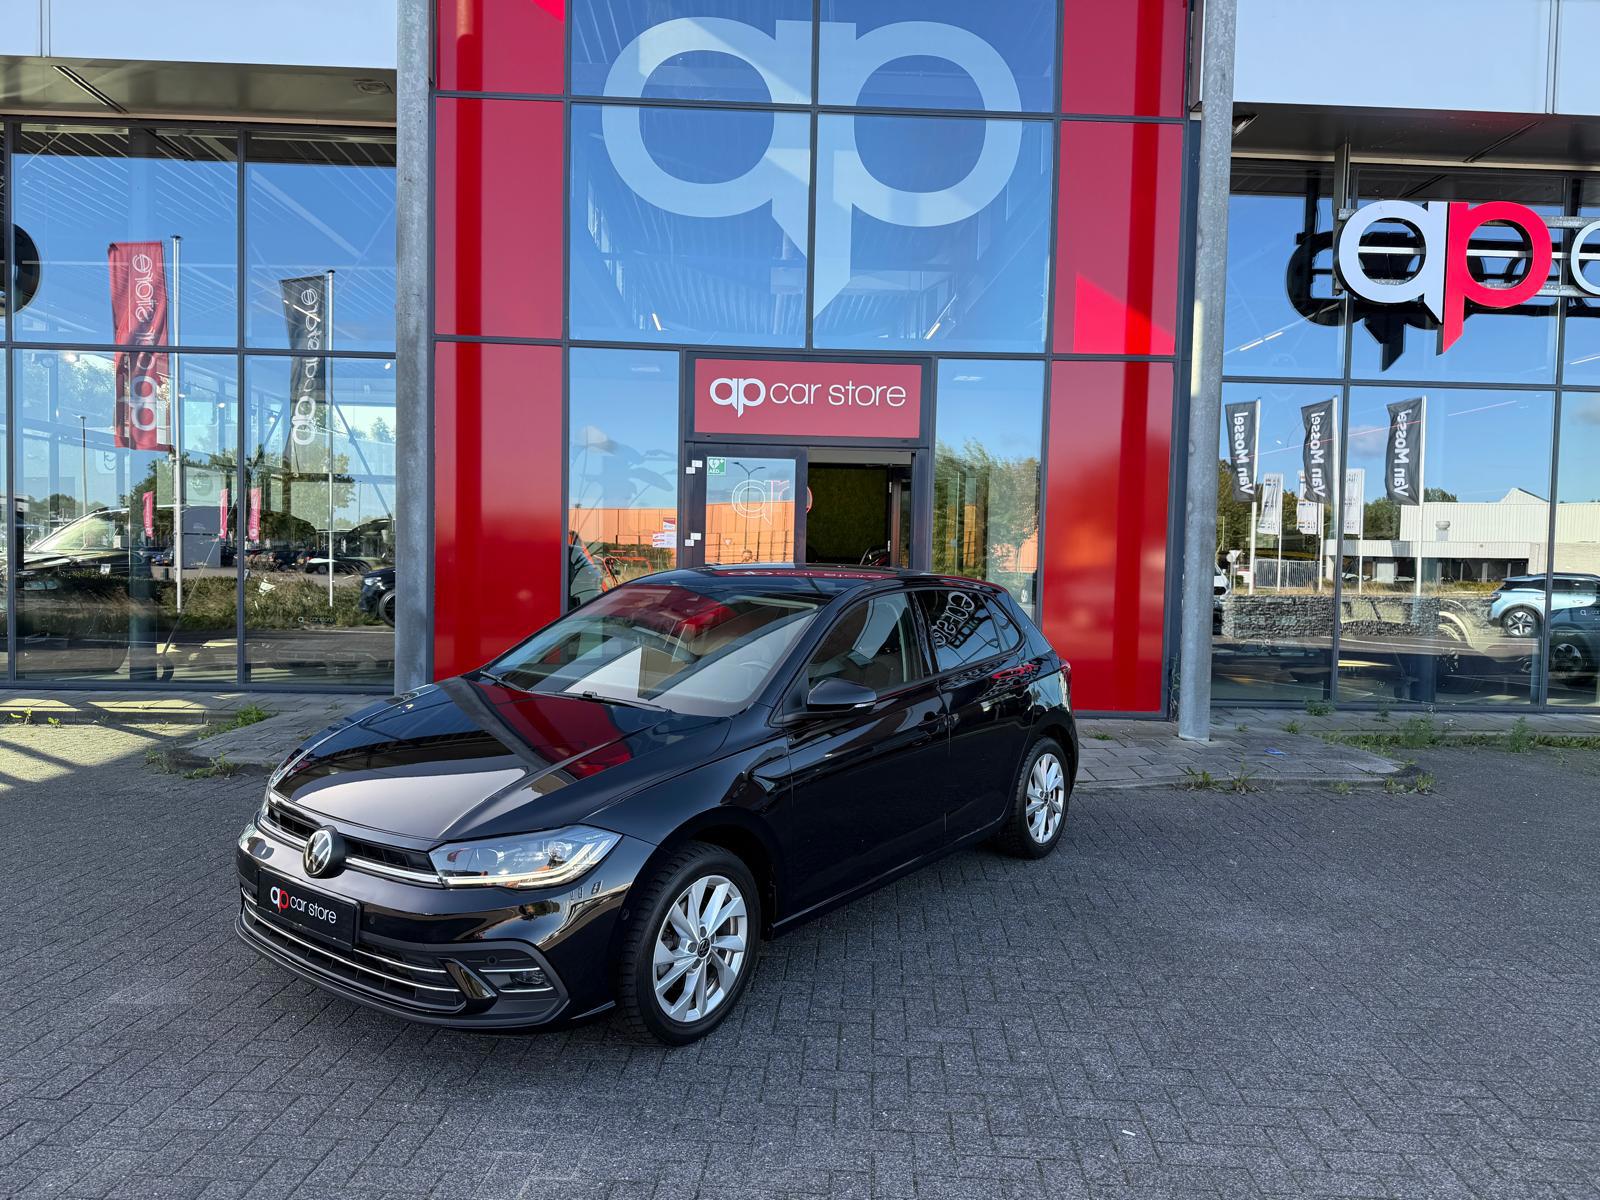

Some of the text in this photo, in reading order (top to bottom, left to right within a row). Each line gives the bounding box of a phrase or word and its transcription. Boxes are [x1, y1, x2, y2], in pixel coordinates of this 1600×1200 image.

[602, 16, 1022, 320] ap
[1339, 200, 1553, 354] ap
[709, 377, 907, 418] ap car store
[270, 886, 337, 924] ap car store
